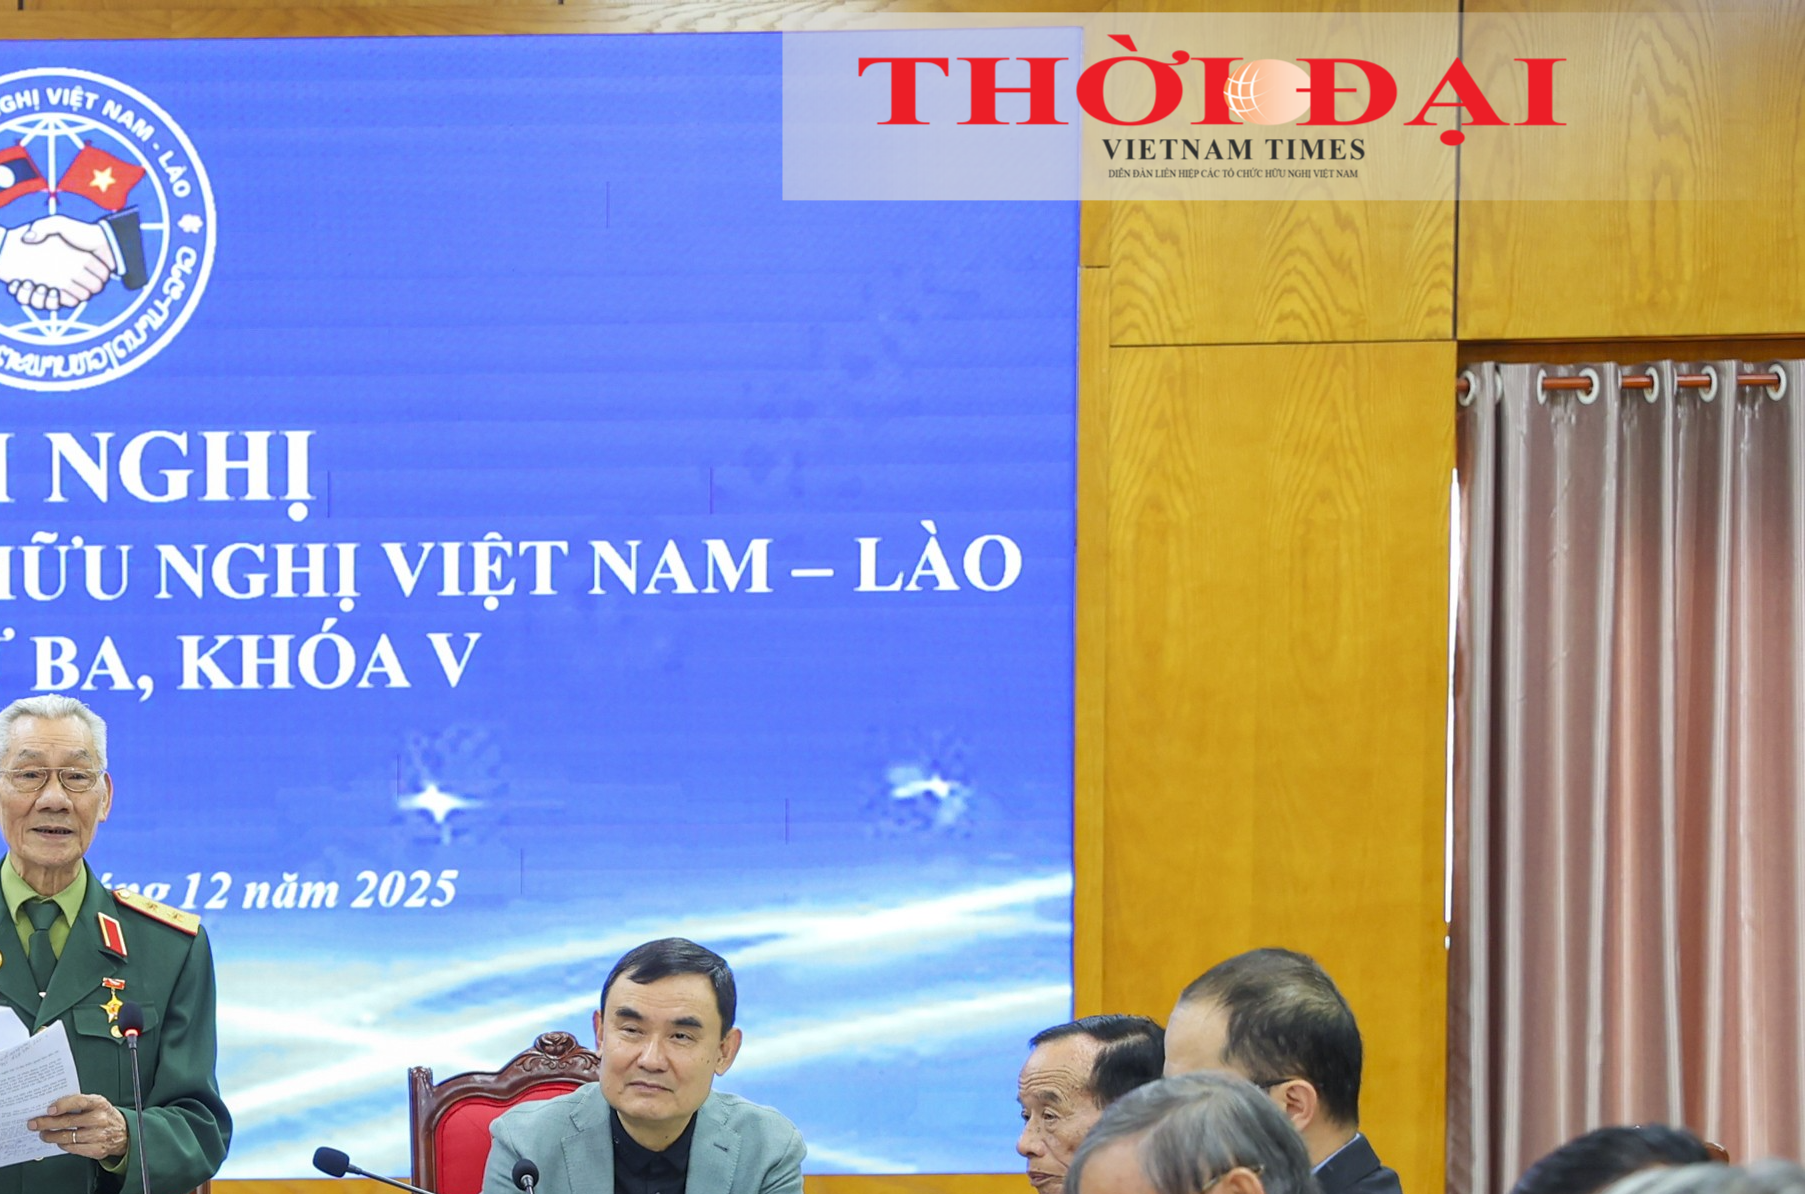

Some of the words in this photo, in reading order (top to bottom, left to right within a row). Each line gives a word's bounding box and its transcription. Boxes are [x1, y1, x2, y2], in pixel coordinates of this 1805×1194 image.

[46, 85, 100, 112] VIỆT
[101, 99, 155, 143] NAM
[44, 430, 315, 522] NGHỊ
[154, 541, 360, 613] NGHỊ
[381, 531, 569, 611] VIỆT
[589, 538, 773, 595] NAM
[854, 520, 1022, 592] LÀO
[30, 635, 154, 702] BA,
[177, 617, 411, 690] KHÓA
[426, 632, 482, 688] V
[178, 871, 232, 910] 12
[242, 872, 340, 910] năm
[350, 869, 459, 909] 2025
